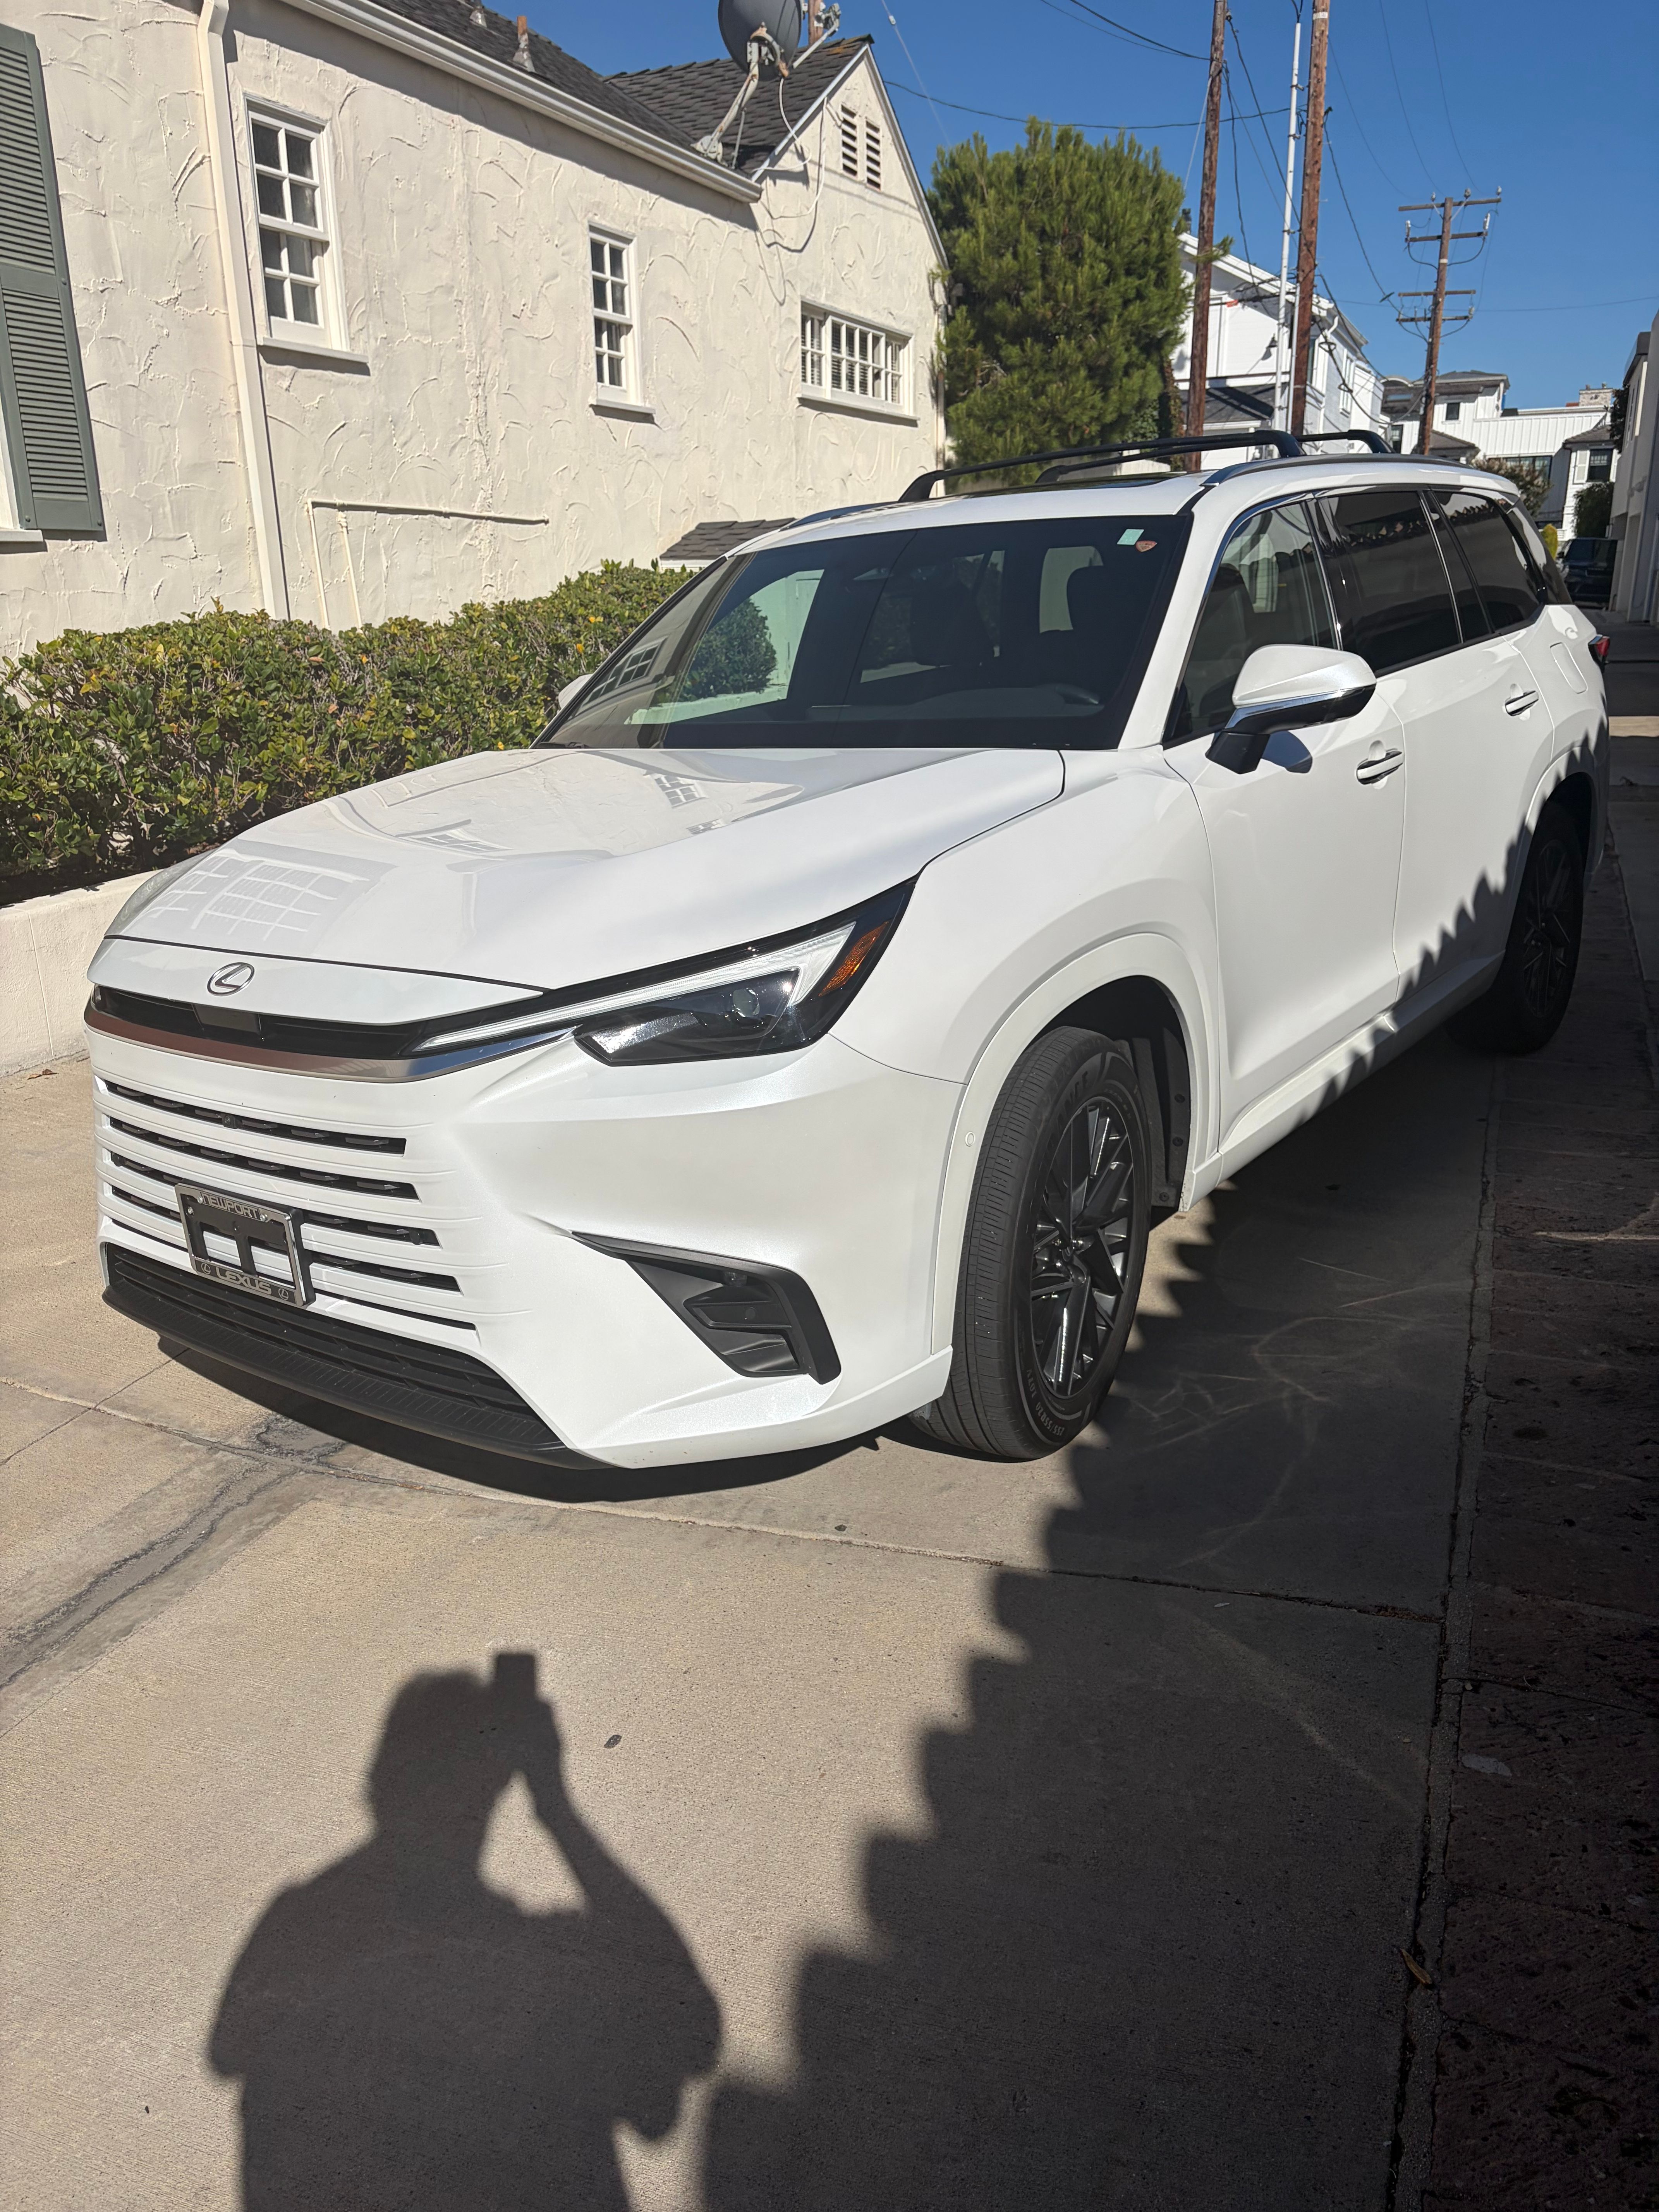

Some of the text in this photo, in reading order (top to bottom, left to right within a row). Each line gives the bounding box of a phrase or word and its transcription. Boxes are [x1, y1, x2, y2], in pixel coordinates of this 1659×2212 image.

[201, 1192, 258, 1219] NEWPORT
[216, 1267, 272, 1295] LEXUS
[1035, 1401, 1065, 1436] 255/55R20
